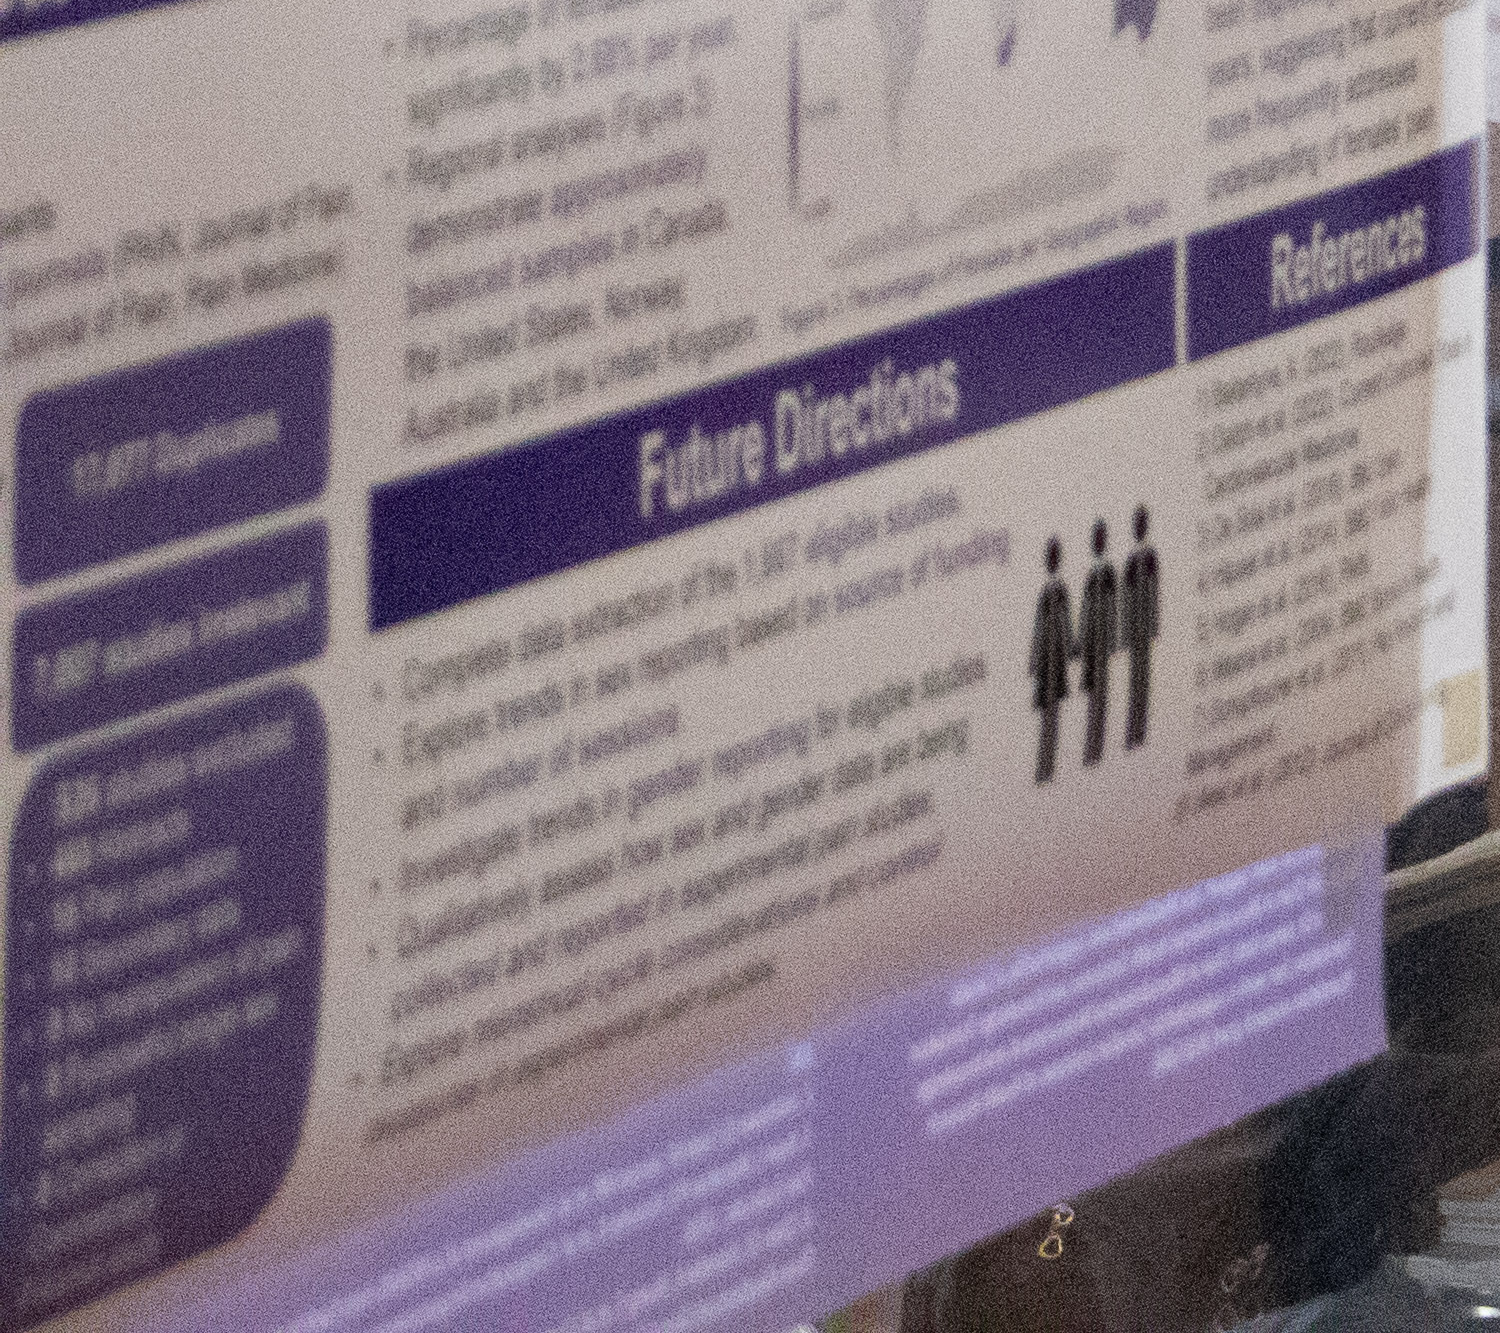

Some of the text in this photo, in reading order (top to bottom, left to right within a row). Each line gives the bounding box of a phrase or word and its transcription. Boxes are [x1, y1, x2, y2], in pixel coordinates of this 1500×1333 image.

[1269, 201, 1428, 312] References
[638, 354, 962, 523] Future Directions
